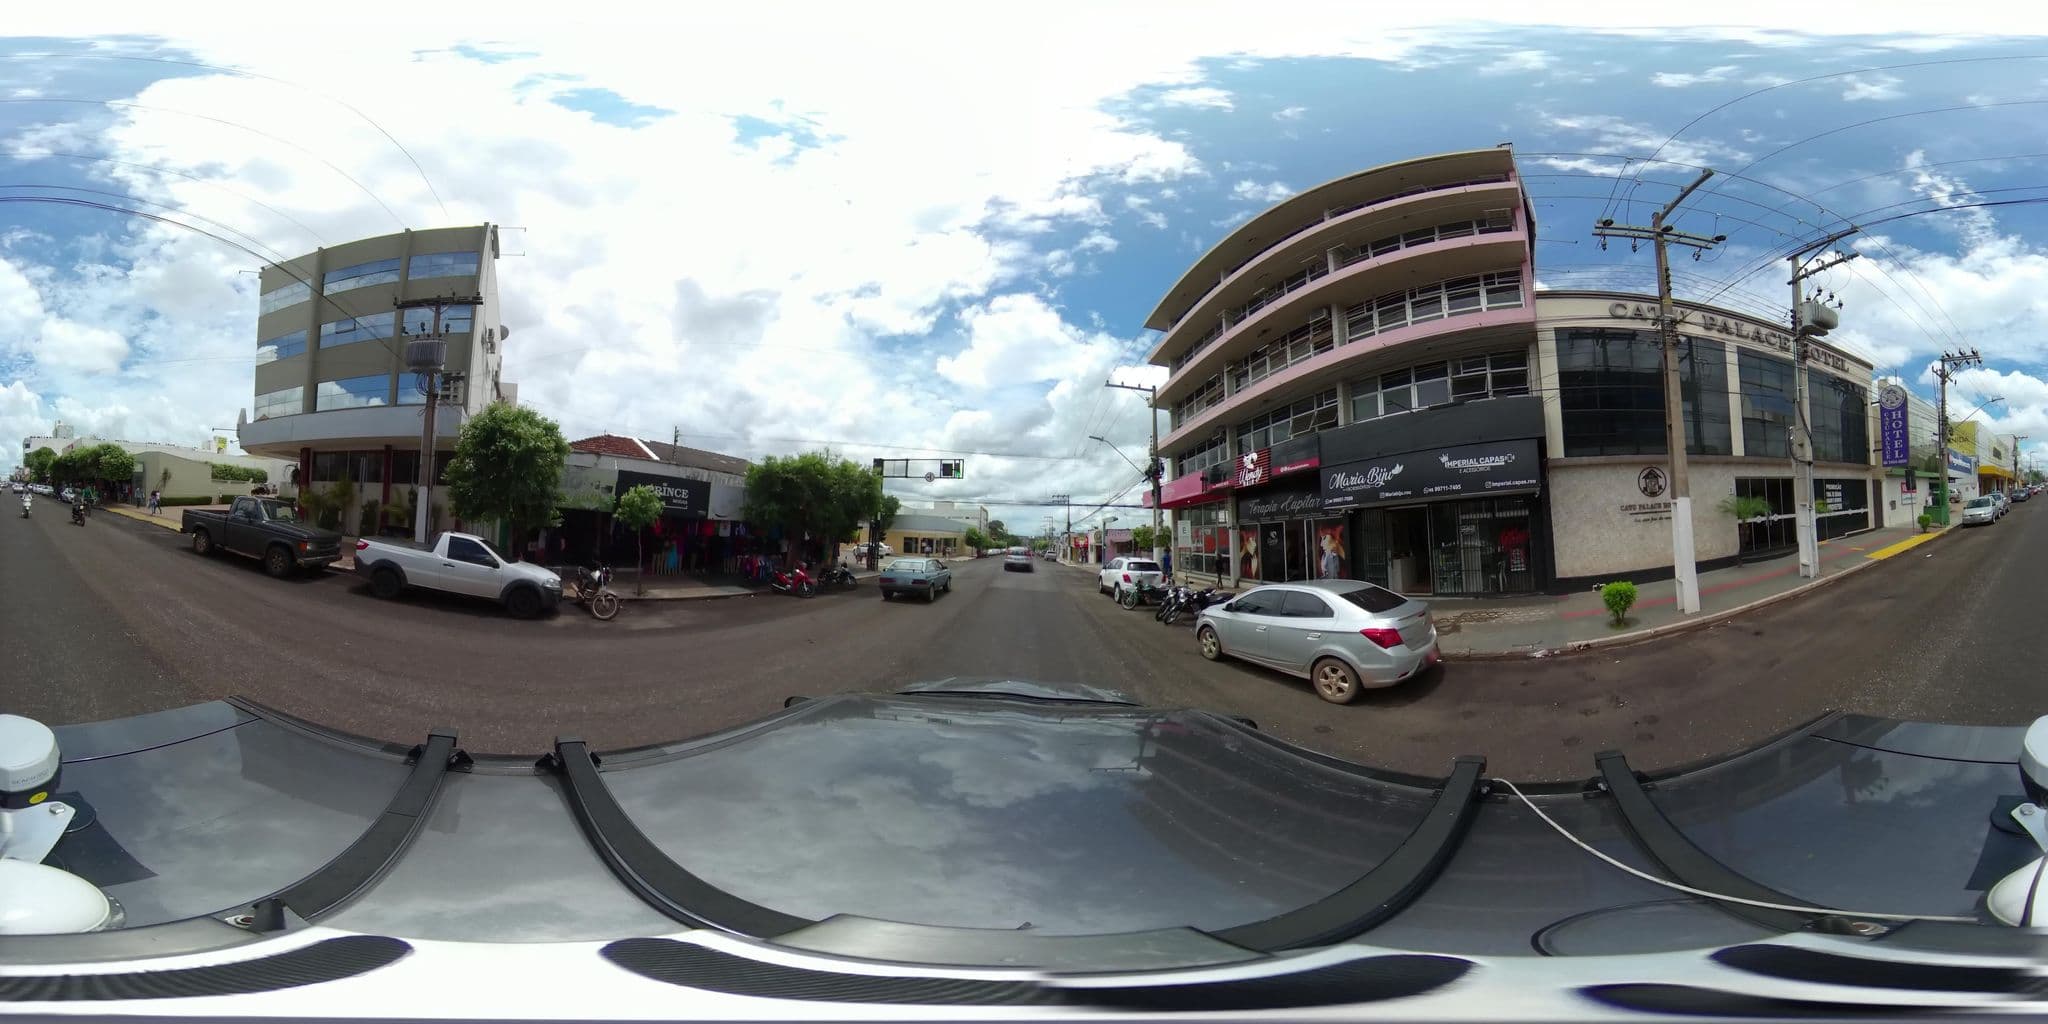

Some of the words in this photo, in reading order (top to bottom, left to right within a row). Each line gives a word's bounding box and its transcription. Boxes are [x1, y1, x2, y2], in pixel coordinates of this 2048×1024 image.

[1702, 313, 1791, 350] PALACE
[1804, 343, 1849, 373] OTEL
[1892, 410, 1904, 459] HOTEL
[1444, 458, 1478, 468] IMPERIAL
[1479, 455, 1505, 464] CAPAS
[1329, 472, 1366, 490] Maria
[1366, 466, 1393, 487] Biju
[1248, 498, 1277, 517] Terapia
[1280, 494, 1321, 514] Capilar
